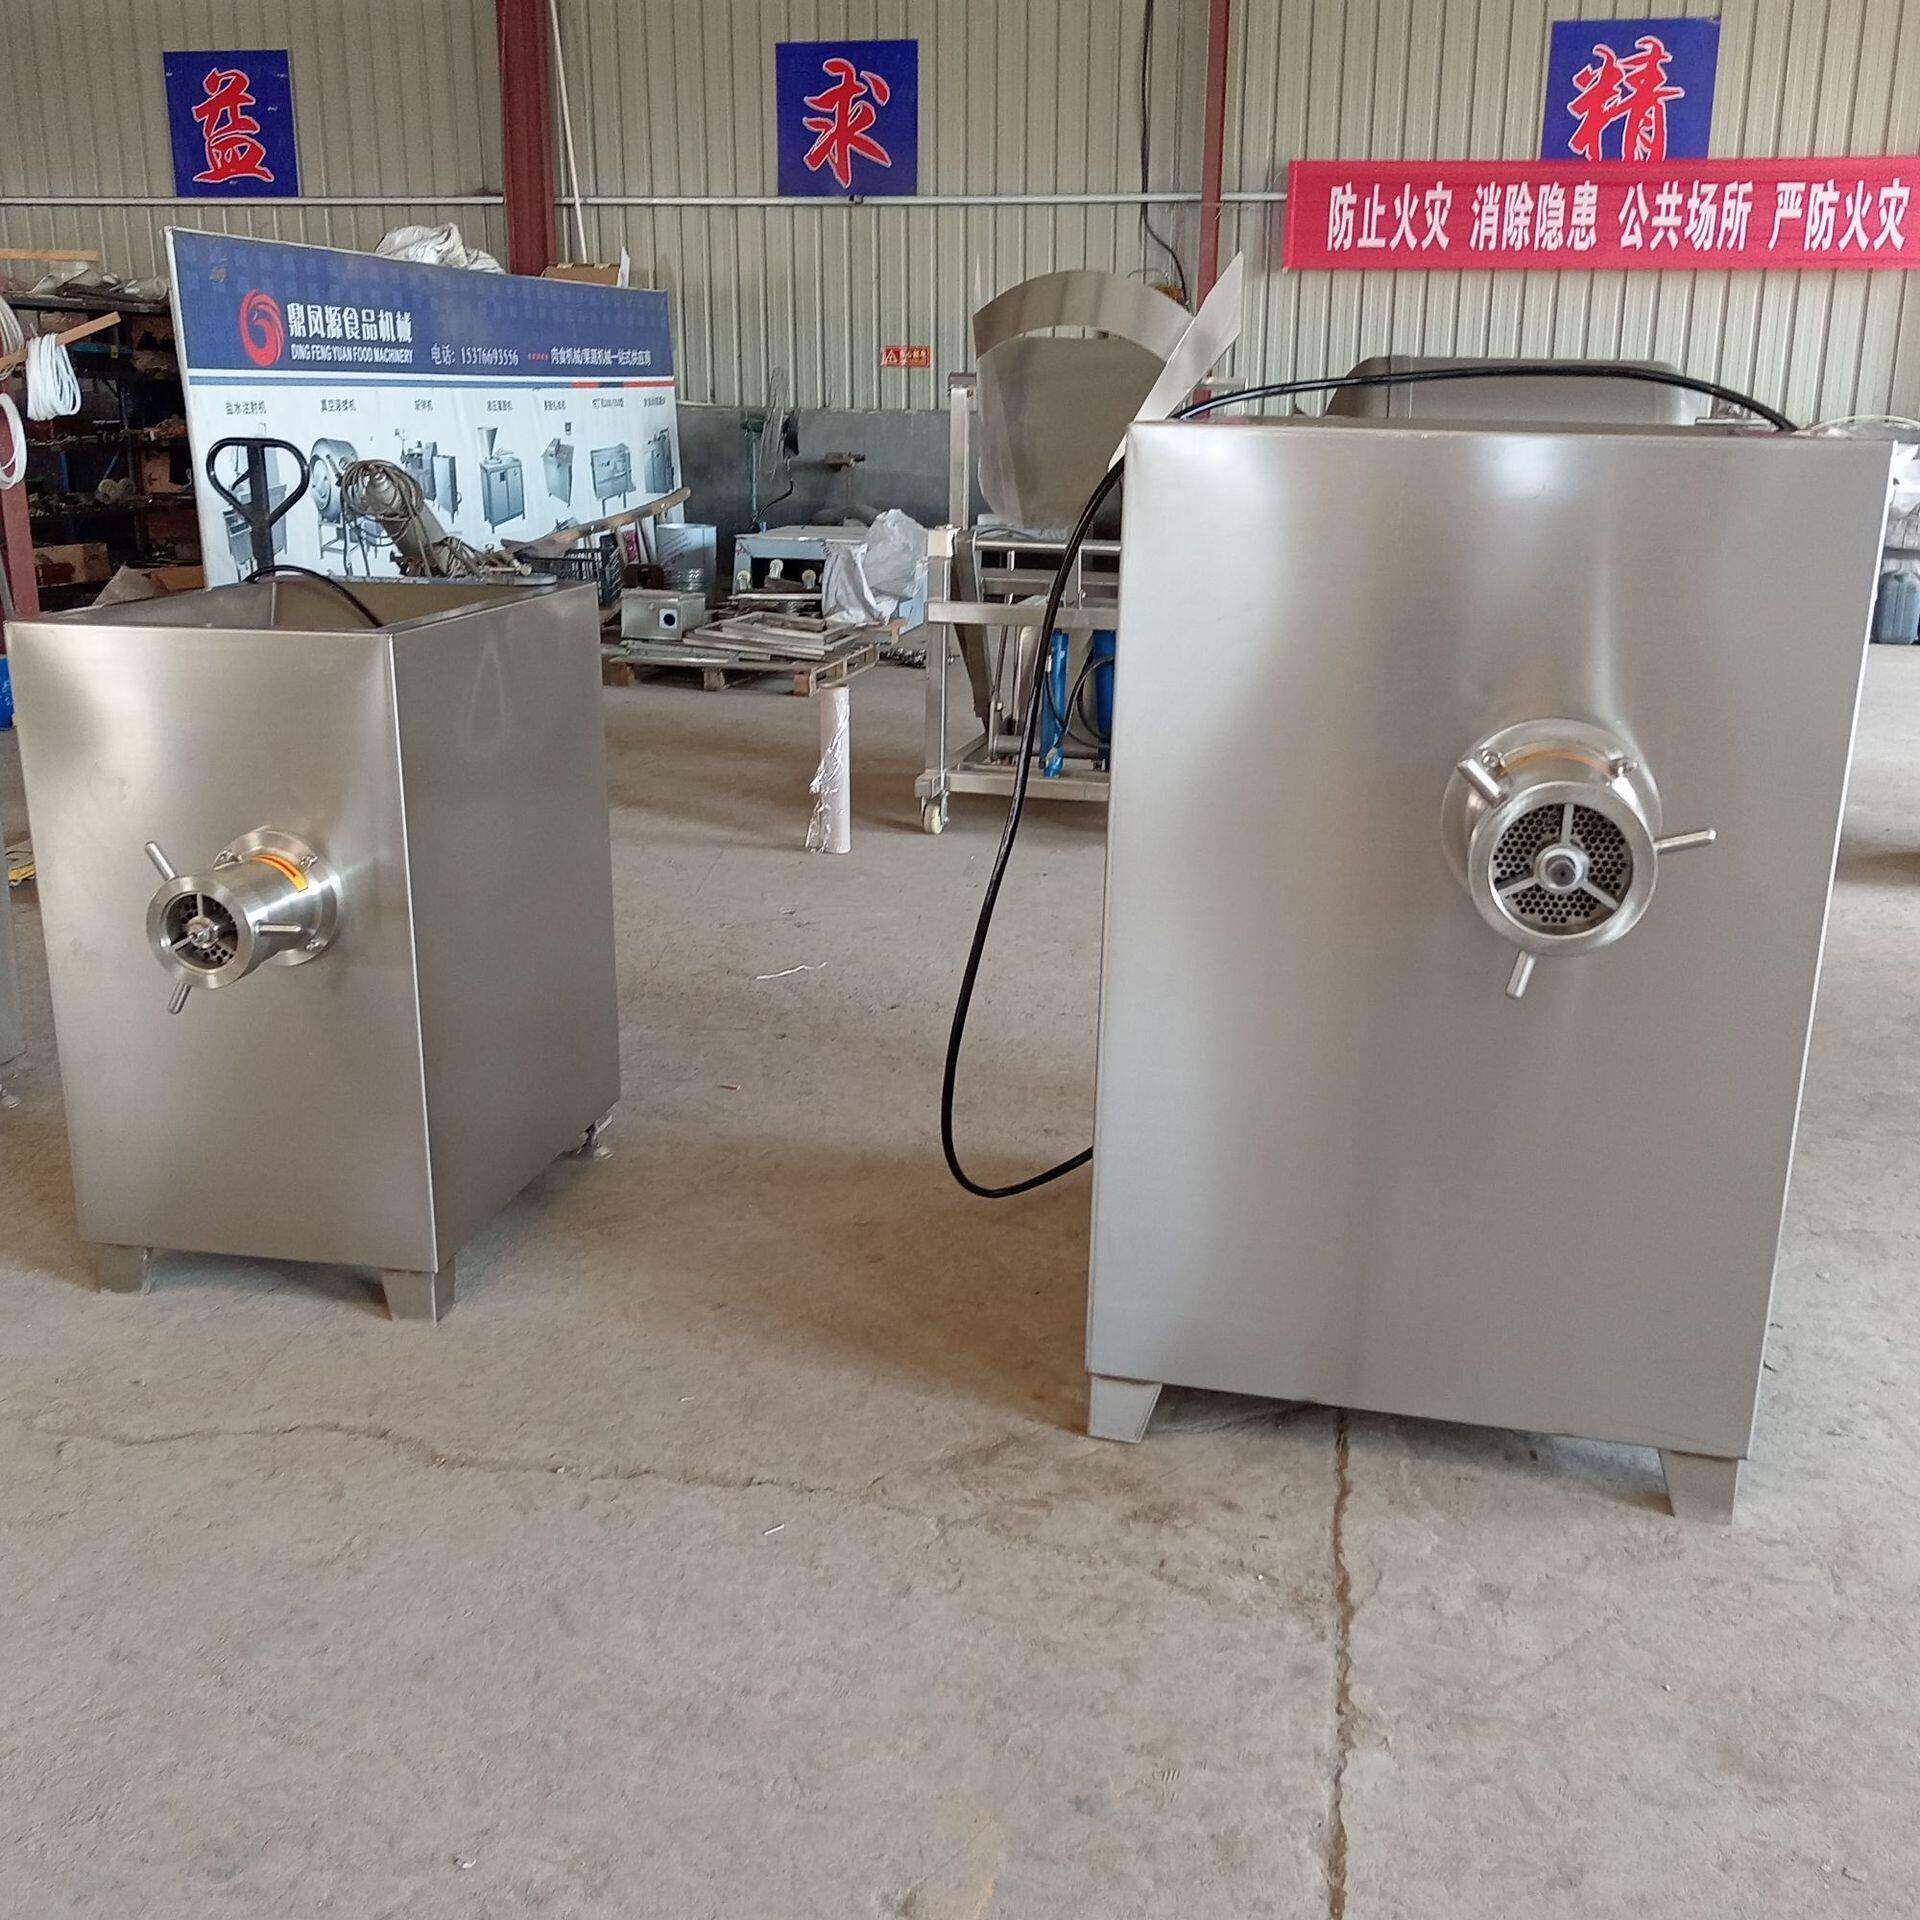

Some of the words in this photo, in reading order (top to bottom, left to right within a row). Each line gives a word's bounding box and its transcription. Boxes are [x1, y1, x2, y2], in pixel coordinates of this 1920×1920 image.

[191, 67, 275, 184] 益
[802, 56, 892, 190] 求
[1566, 35, 1686, 161] 精
[1327, 182, 1453, 253] 防止火灾
[1469, 180, 1600, 253] 消除隐患
[1618, 180, 1754, 253] 公共场所
[1768, 178, 1911, 253] 严防火灾
[290, 343, 311, 360] DING
[311, 344, 331, 361] FENG
[332, 345, 353, 362] YUAN
[353, 346, 374, 362] FOOD
